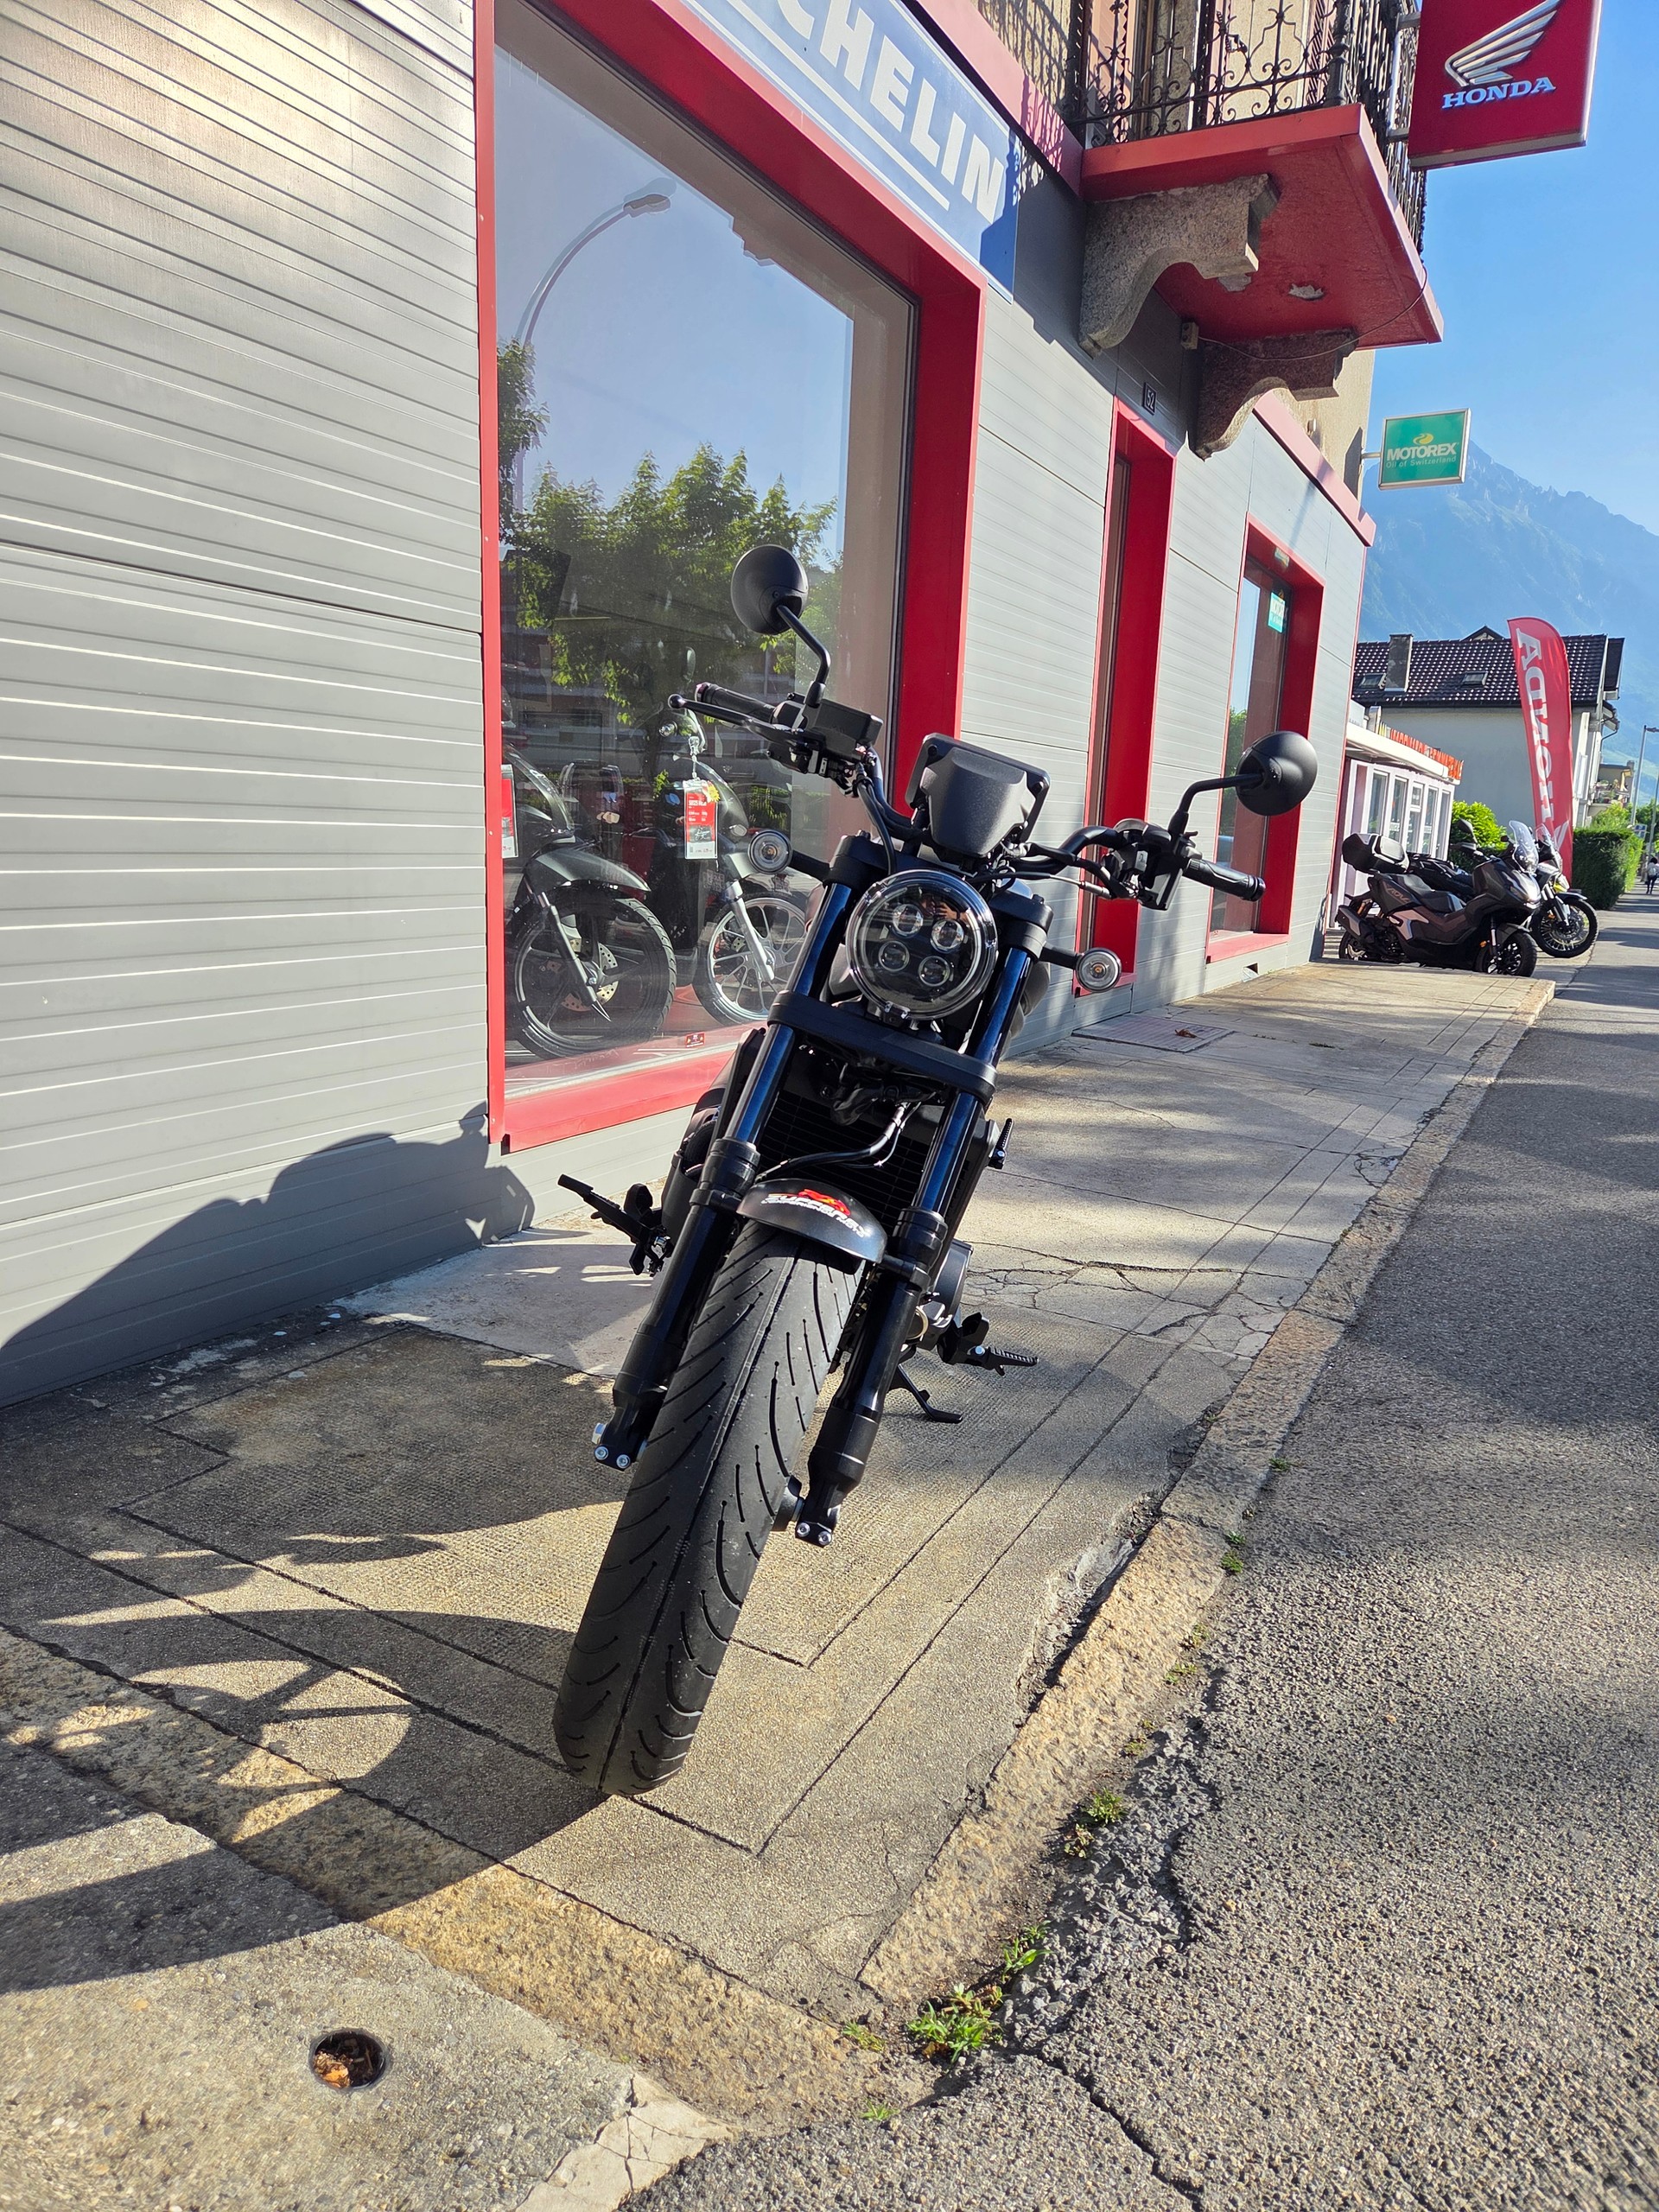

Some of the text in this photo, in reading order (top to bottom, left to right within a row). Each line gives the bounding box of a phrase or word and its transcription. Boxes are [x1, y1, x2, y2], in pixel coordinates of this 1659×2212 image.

[1441, 77, 1556, 109] HONDA
[1147, 389, 1154, 410] 52
[1386, 442, 1457, 461] MOTOREX
[1410, 455, 1457, 467] Switzerland
[1386, 887, 1411, 903] ADV
